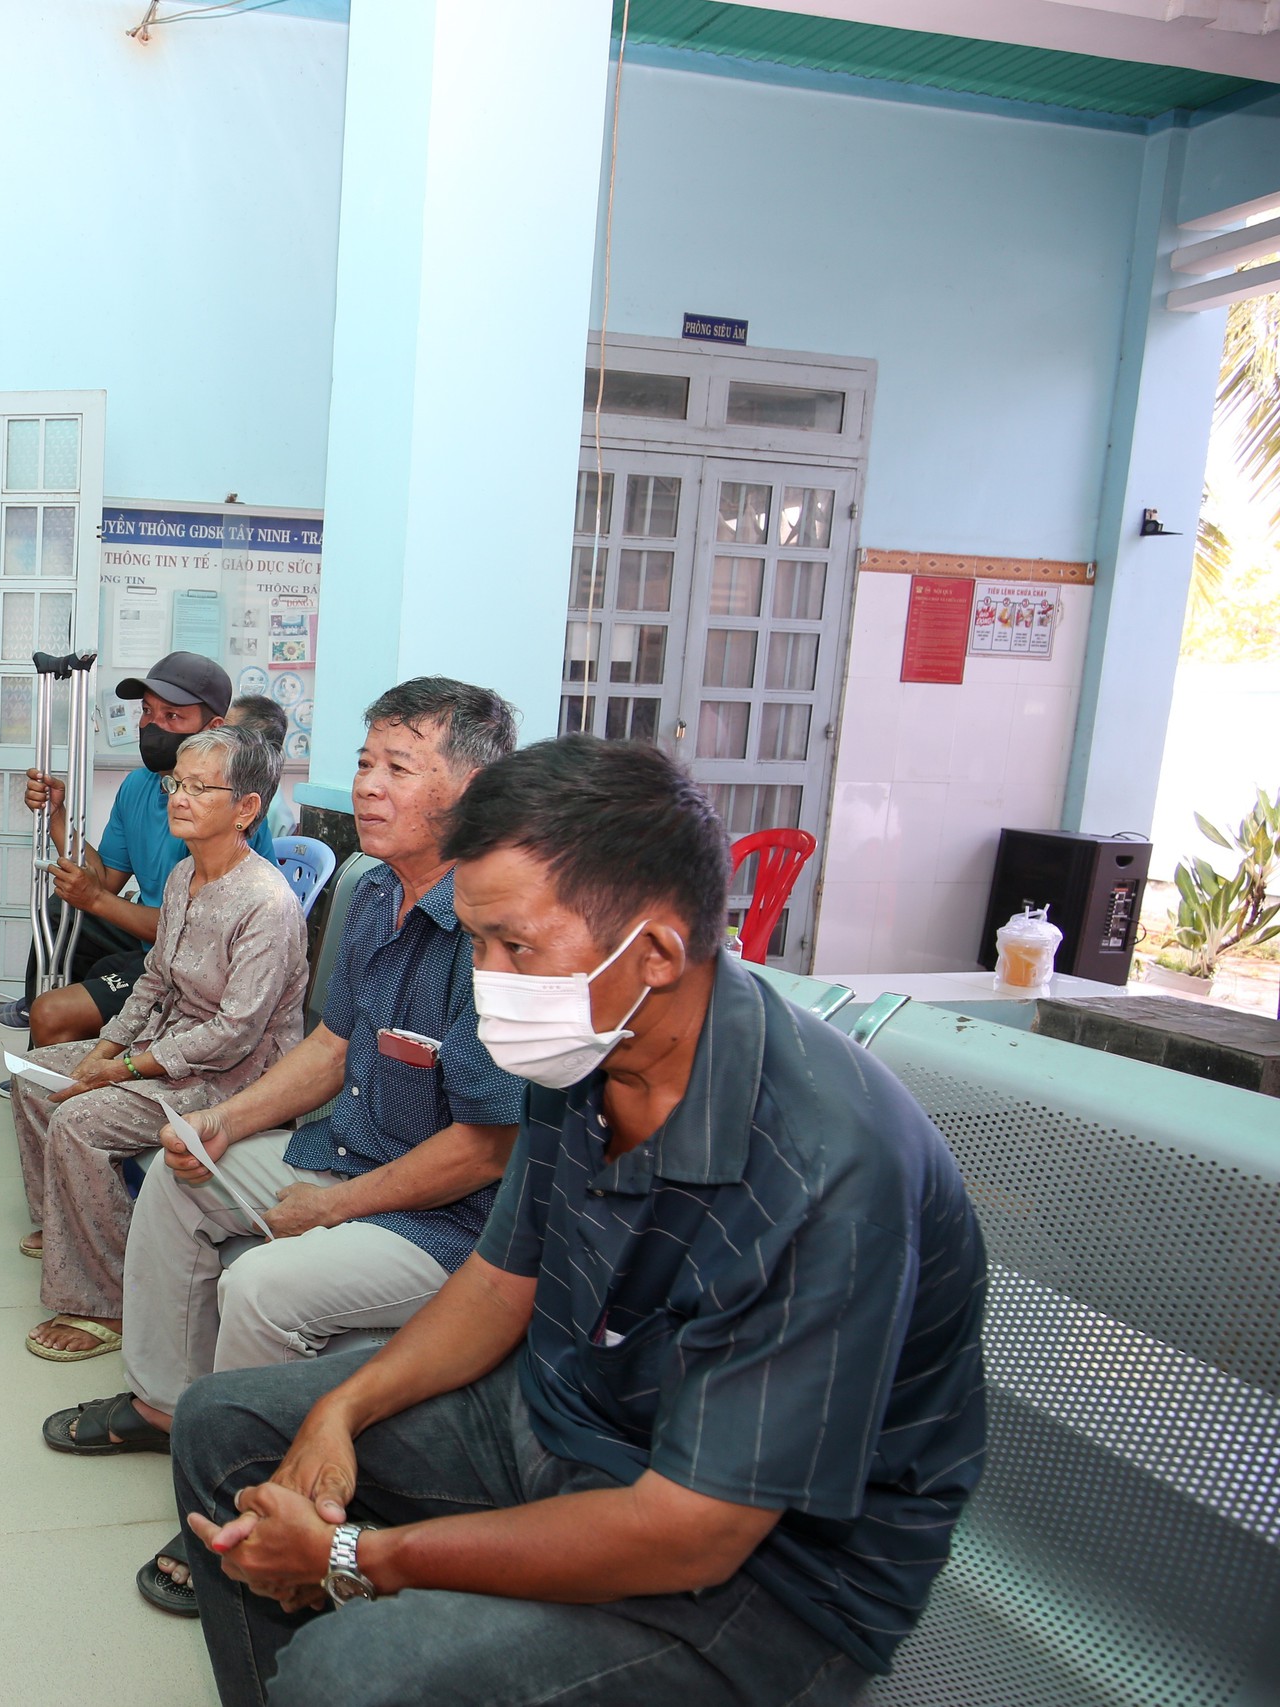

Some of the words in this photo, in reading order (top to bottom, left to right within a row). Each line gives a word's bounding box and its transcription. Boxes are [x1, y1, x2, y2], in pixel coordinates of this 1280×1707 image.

[685, 320, 711, 336] PHÒNG
[713, 323, 731, 338] SIÊU
[732, 325, 745, 339] ÂM
[138, 519, 186, 538] THÔNG
[189, 524, 224, 540] GDSK
[228, 523, 254, 541] TÂY
[257, 528, 291, 544] NINH
[104, 550, 151, 566] THÔNG
[155, 554, 178, 568] TIN
[181, 556, 190, 568] Y
[193, 552, 210, 569] TẾ
[222, 554, 254, 571] GIÁO
[256, 559, 284, 576] DỤC
[288, 558, 313, 574] SỨC
[124, 575, 145, 584] TIN
[256, 583, 299, 594] THÔNG
